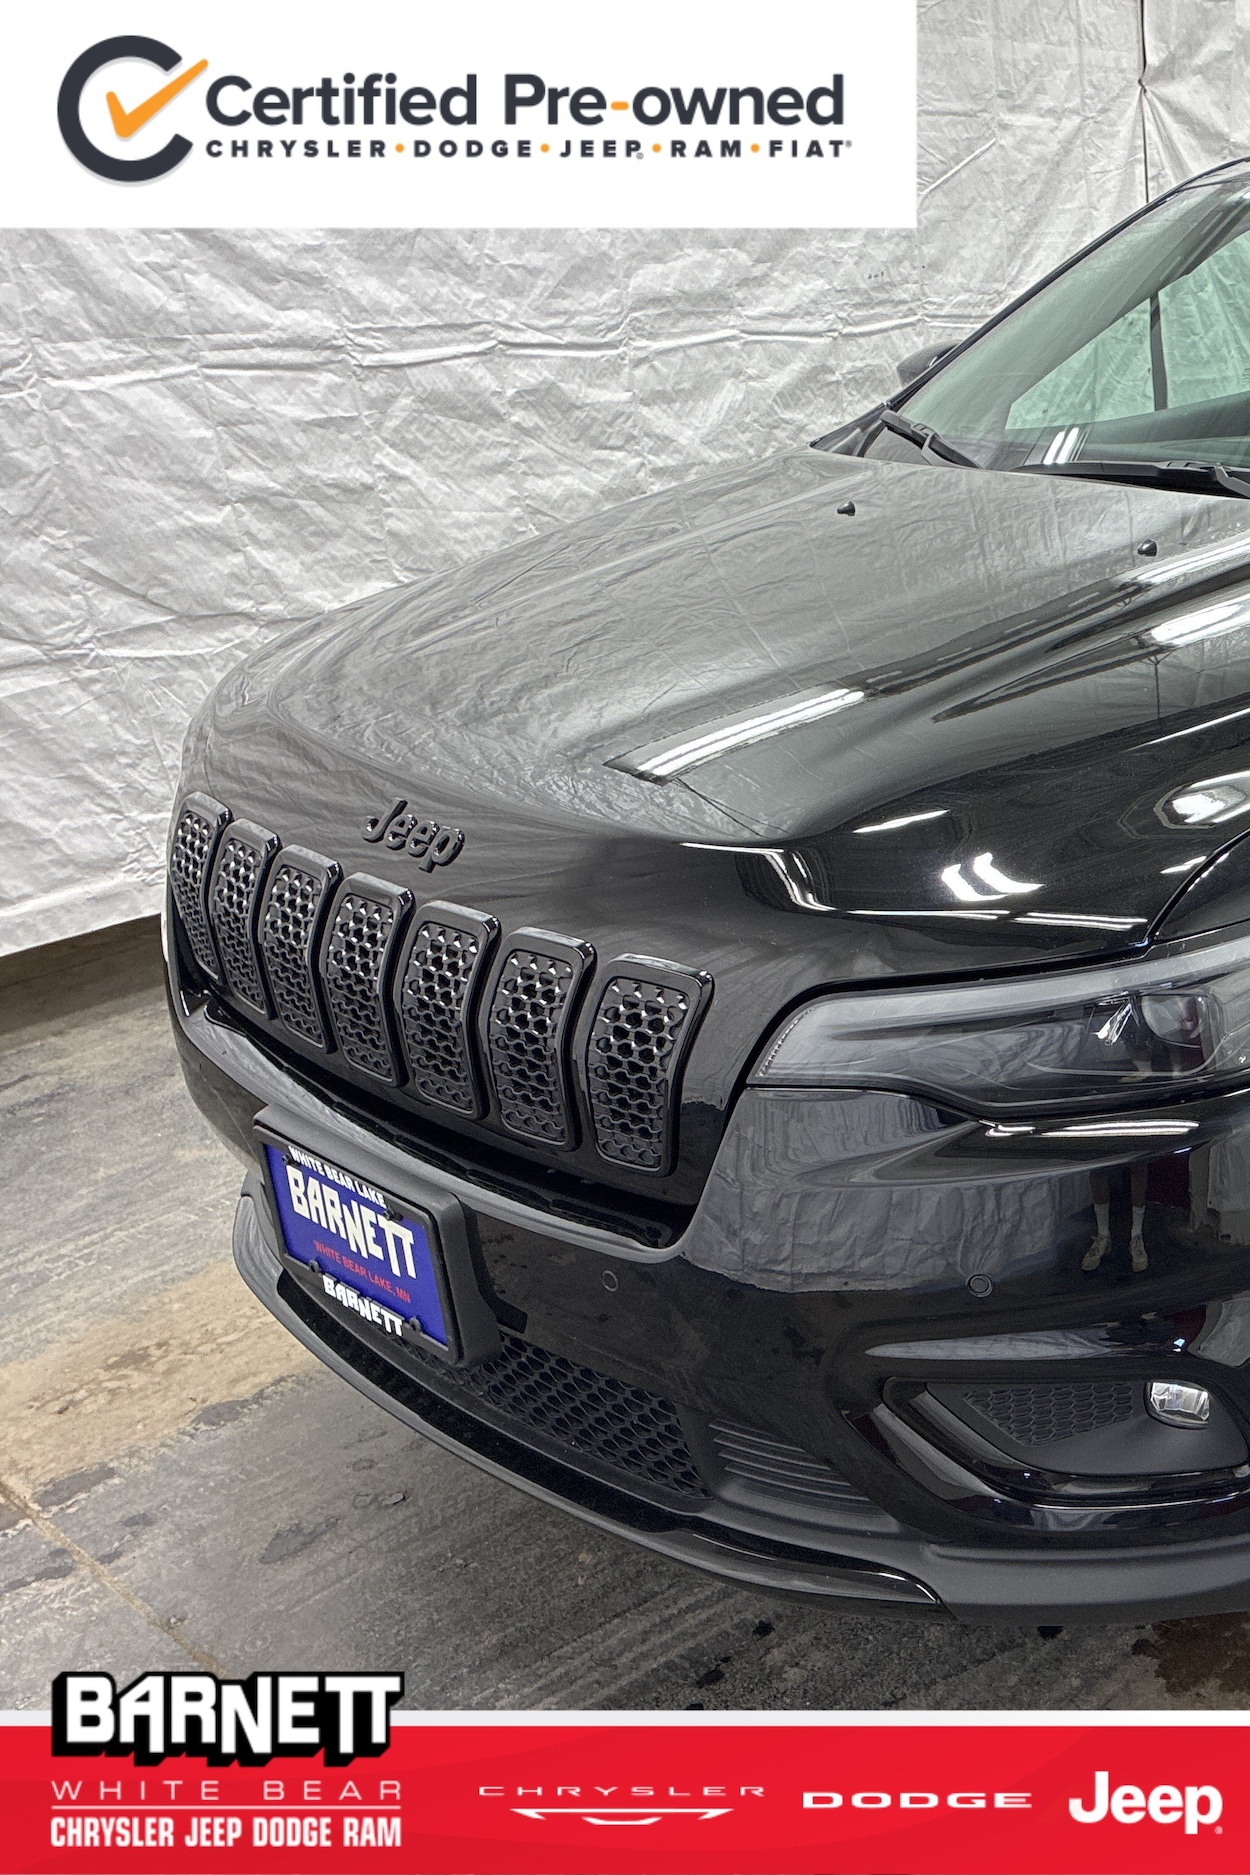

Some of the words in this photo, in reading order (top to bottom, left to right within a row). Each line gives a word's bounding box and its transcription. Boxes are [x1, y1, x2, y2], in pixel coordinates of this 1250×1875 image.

[362, 797, 465, 873] Jeep
[288, 1145, 326, 1177] WHITE
[323, 1164, 356, 1193] BEAR
[354, 1181, 388, 1209] LAKE
[286, 1164, 417, 1279] BARNETT
[314, 1240, 343, 1265] WHITE
[341, 1256, 369, 1279] BEAR
[395, 1285, 411, 1304] MN
[322, 1272, 404, 1337] BARNETT
